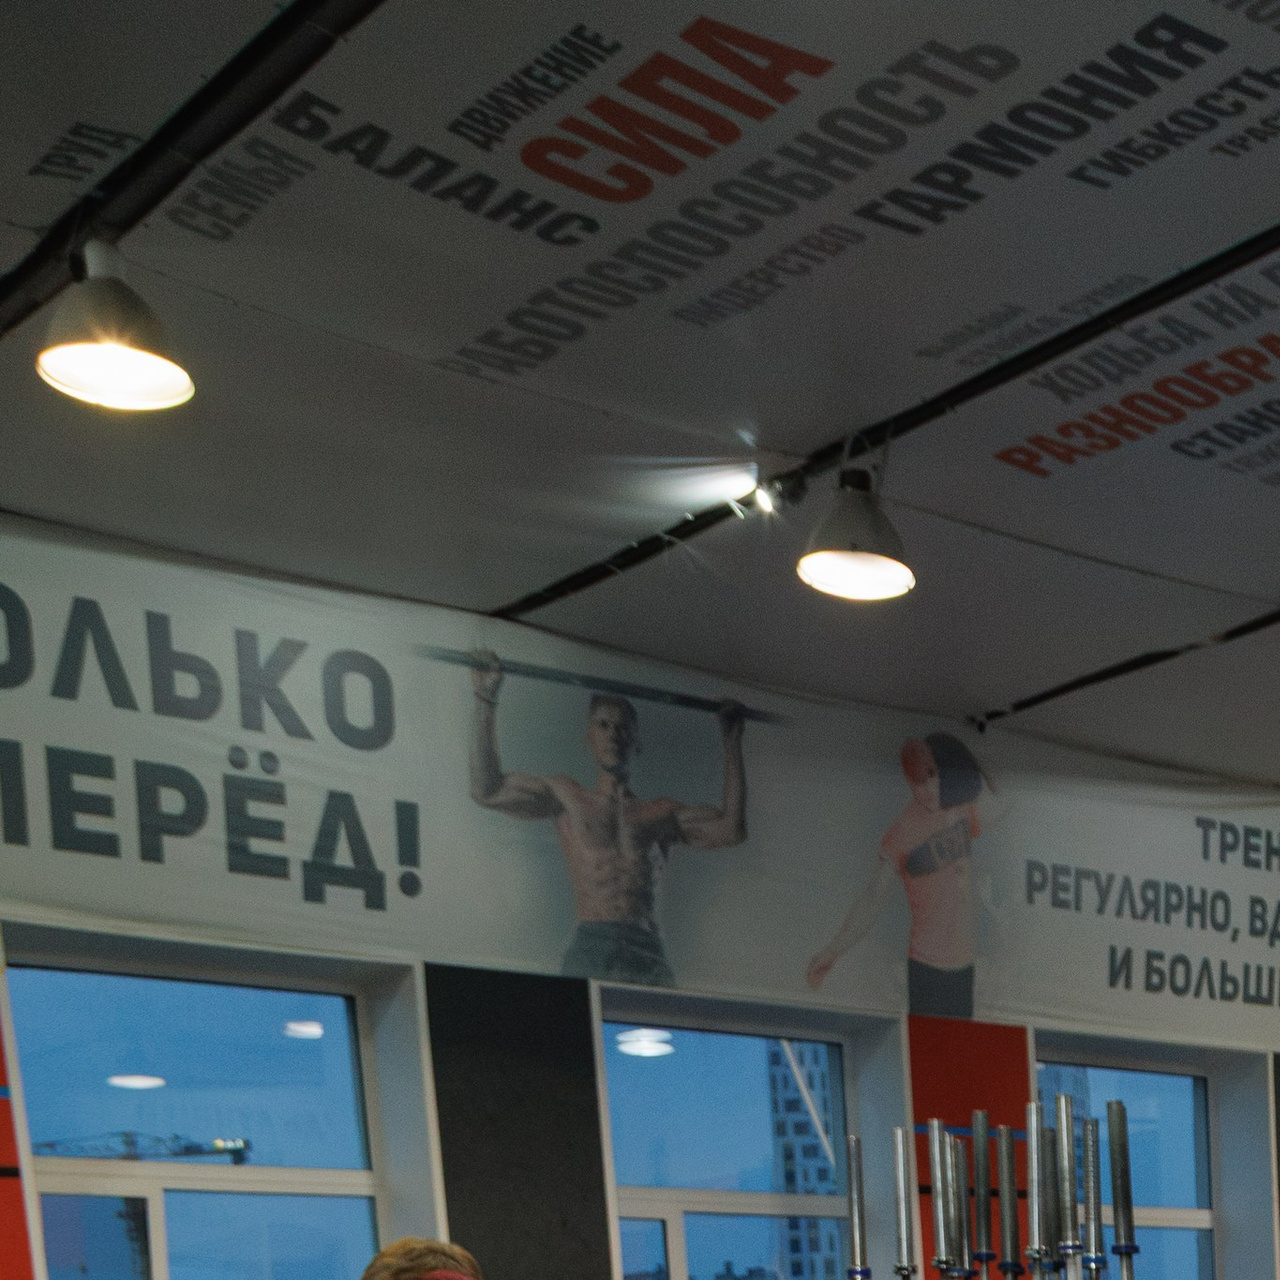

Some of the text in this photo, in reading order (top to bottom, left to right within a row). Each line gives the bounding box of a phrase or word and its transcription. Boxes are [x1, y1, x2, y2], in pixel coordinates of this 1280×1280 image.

[446, 23, 622, 152] ДВИЖЕНИЕ
[519, 15, 836, 203] СИЛА
[853, 12, 1229, 236] ГАРМОНИЯ
[28, 121, 143, 181] ТРУД
[165, 137, 316, 242] СЕМЬЯ
[273, 91, 600, 246] БАЛАНС
[433, 39, 1020, 382] РАБОТОСПОСОБНОСТЬ
[672, 223, 867, 328] ЛИДЕРСТВО
[1028, 315, 1209, 405] ХОДЬБА
[1192, 281, 1280, 333] НА
[1024, 858, 1239, 942] РЕГУЛЯРНО,
[1108, 944, 1133, 989] И
